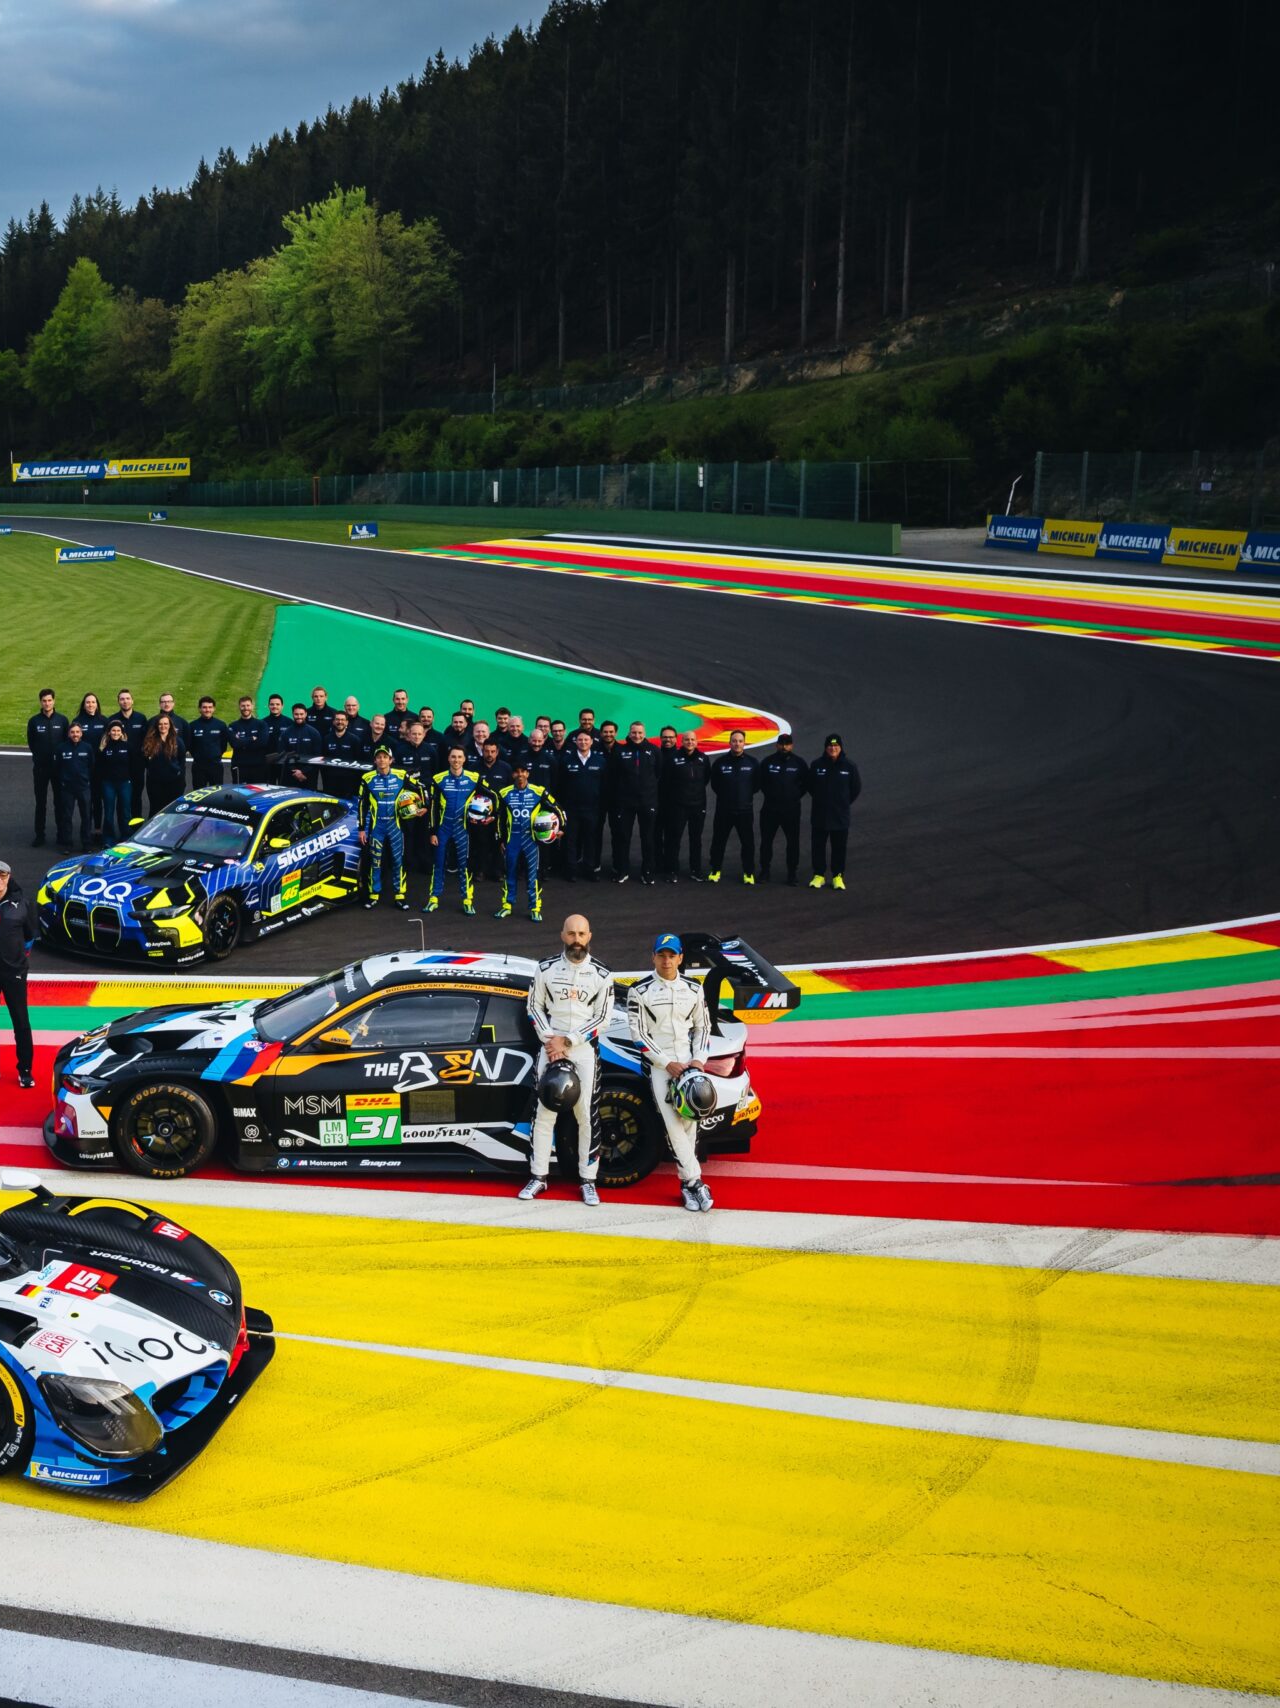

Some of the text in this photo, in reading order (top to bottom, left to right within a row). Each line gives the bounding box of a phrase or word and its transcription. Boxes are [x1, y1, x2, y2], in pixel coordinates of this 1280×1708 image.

[32, 464, 101, 475] MICHELIN
[121, 461, 188, 472] MICHELIN
[996, 525, 1037, 539] MICHELIN
[1050, 529, 1096, 544] MICHELIN
[1108, 534, 1161, 550] MICHELIN
[1178, 540, 1238, 556] MICHELIN
[68, 549, 115, 558] MICHELIN
[208, 808, 250, 821] Motorsport
[512, 808, 530, 818] OQ
[277, 824, 351, 870] SKECHERS
[79, 877, 133, 902] OQ
[282, 885, 299, 902] 46
[764, 992, 788, 1008] M
[364, 1063, 398, 1078] THE
[284, 1094, 342, 1116] MSM
[354, 1097, 393, 1107] DHL
[325, 1121, 342, 1132] LM
[350, 1115, 399, 1140] 31
[402, 1126, 471, 1140] GOODYEAR
[323, 1132, 345, 1144] GT3
[359, 1159, 402, 1168] Snap-on
[158, 1222, 185, 1240] HY
[89, 1250, 170, 1274] Motorsport
[64, 1270, 102, 1293] 15
[40, 1296, 52, 1309] FIA
[45, 1333, 72, 1354] CAR
[8, 1381, 18, 1398] SPORT
[52, 1470, 102, 1482] MICHELIN
